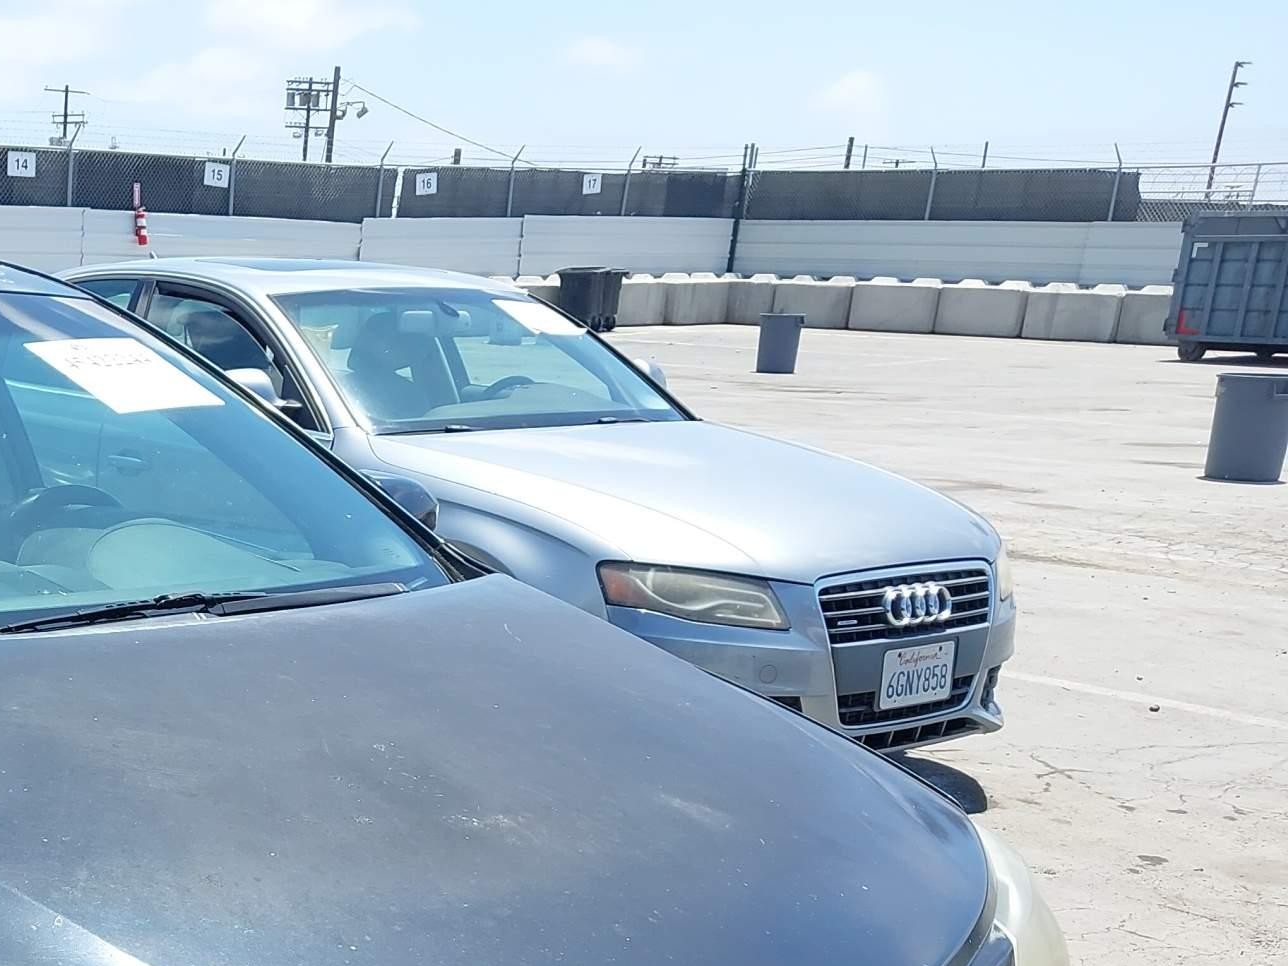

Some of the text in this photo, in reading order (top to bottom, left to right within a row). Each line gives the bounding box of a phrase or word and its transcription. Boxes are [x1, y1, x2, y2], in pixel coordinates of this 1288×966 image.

[15, 158, 28, 170] 14
[211, 168, 223, 181] 15
[422, 178, 432, 189] 16
[588, 178, 597, 189] 17
[886, 663, 948, 699] 6GNY858
